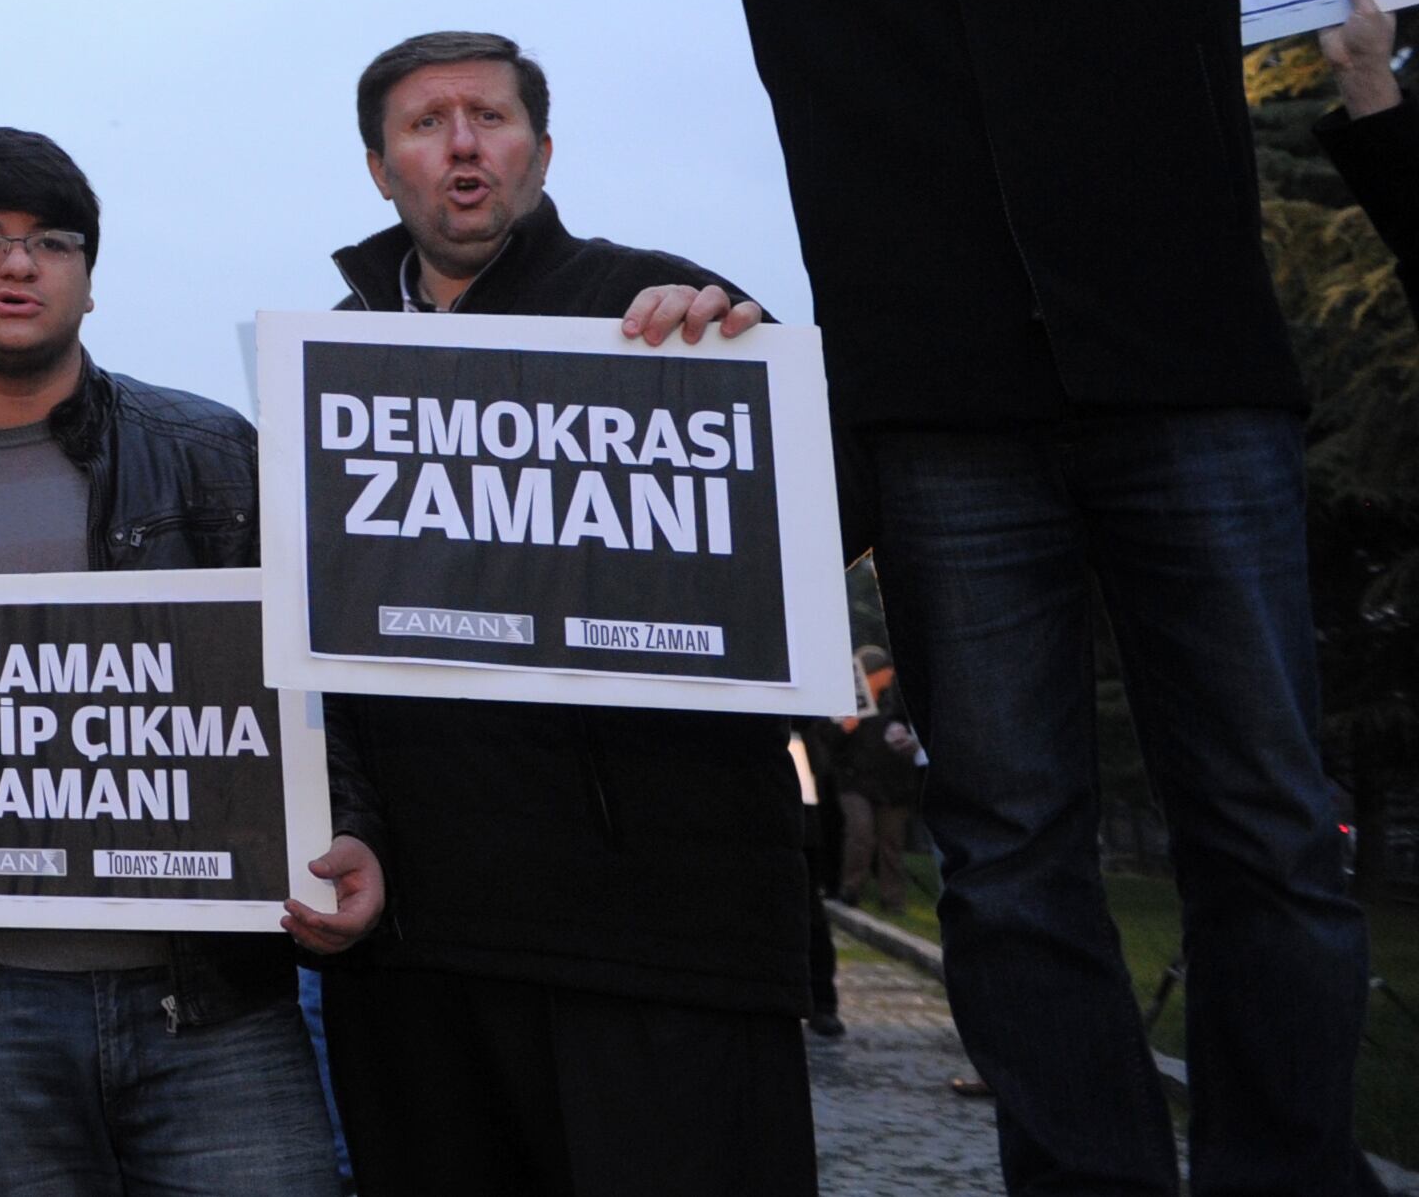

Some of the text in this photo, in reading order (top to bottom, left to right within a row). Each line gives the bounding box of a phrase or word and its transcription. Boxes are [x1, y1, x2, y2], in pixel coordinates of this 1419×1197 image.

[320, 393, 754, 471] DEMOKRASİ
[344, 458, 732, 555] ZAMANI
[385, 612, 501, 638] ZAMAN
[645, 624, 710, 652] ZAMAN
[70, 704, 270, 762] ÇIKMA
[163, 853, 219, 877] ZAMAN
